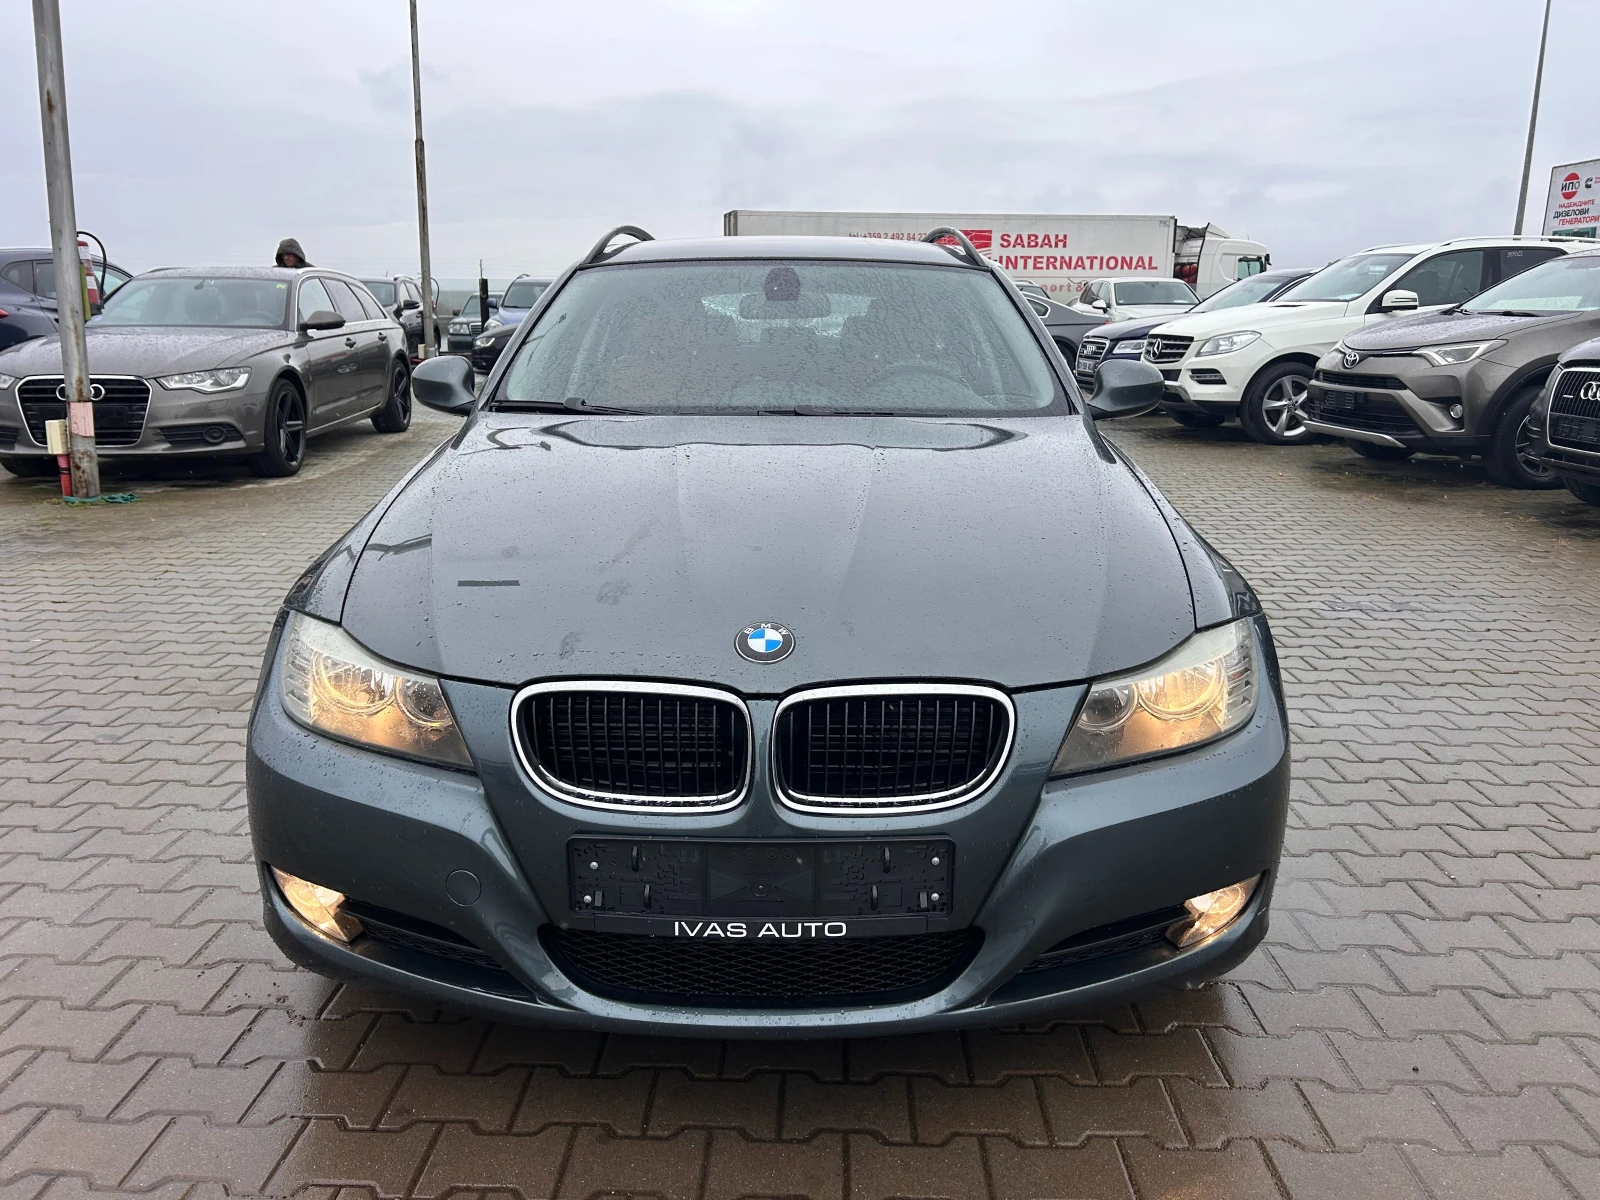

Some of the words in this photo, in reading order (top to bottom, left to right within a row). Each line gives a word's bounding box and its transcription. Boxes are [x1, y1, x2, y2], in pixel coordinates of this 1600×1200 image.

[1561, 181, 1580, 192] ИПО
[1553, 208, 1590, 219] ДИЗЕЛОВИ
[1558, 215, 1600, 226] ГЕНЕРАТОРИ
[890, 232, 905, 241] 492
[906, 232, 916, 242] 84
[1000, 233, 1068, 248] SABAH
[999, 255, 1158, 270] INTERNATIONAL
[743, 623, 789, 634] BMW
[674, 921, 747, 938] IVAS
[757, 921, 847, 938] AUTO
